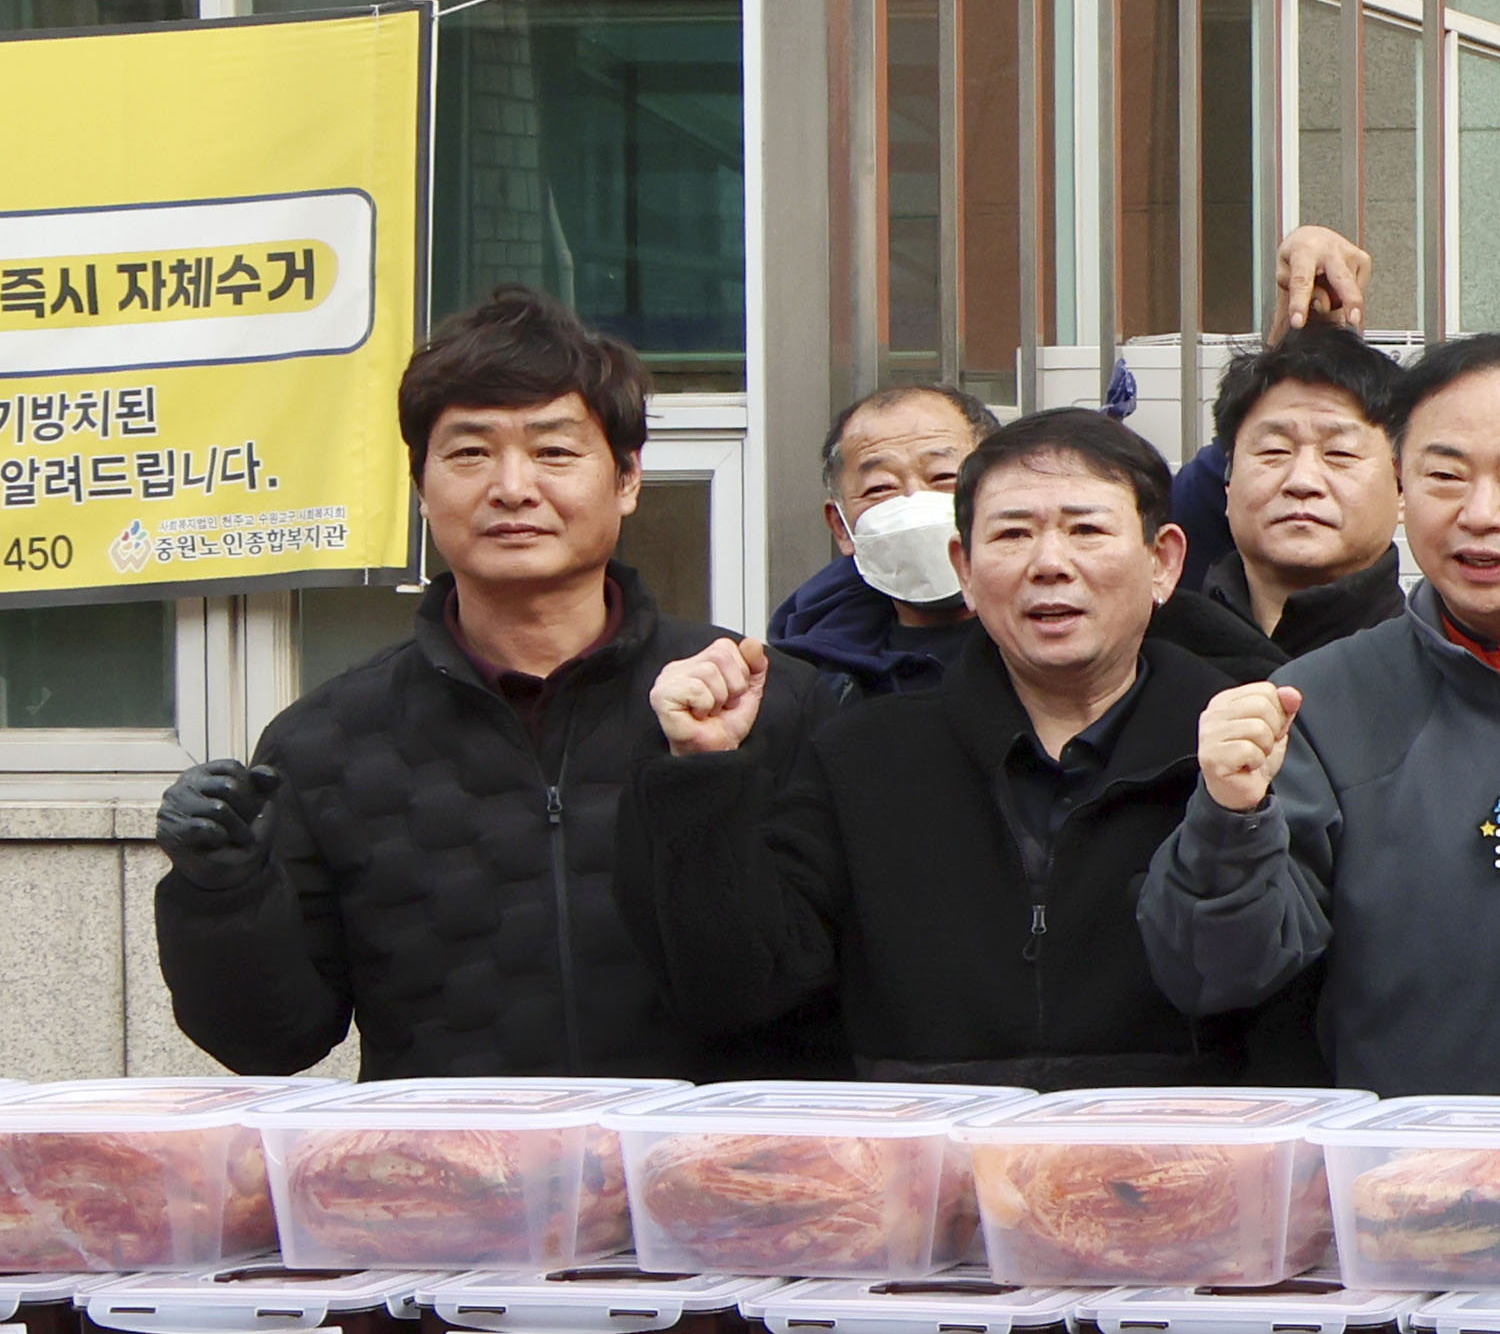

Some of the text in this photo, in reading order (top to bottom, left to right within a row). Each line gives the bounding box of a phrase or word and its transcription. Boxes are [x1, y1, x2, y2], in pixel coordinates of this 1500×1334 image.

[0, 248, 315, 319] 즉시 자체수거
[1, 441, 279, 506] 알려드립니다.
[222, 513, 254, 528] 천주교
[4, 534, 74, 572] 450
[155, 524, 347, 561] 중원노인종합복지관
